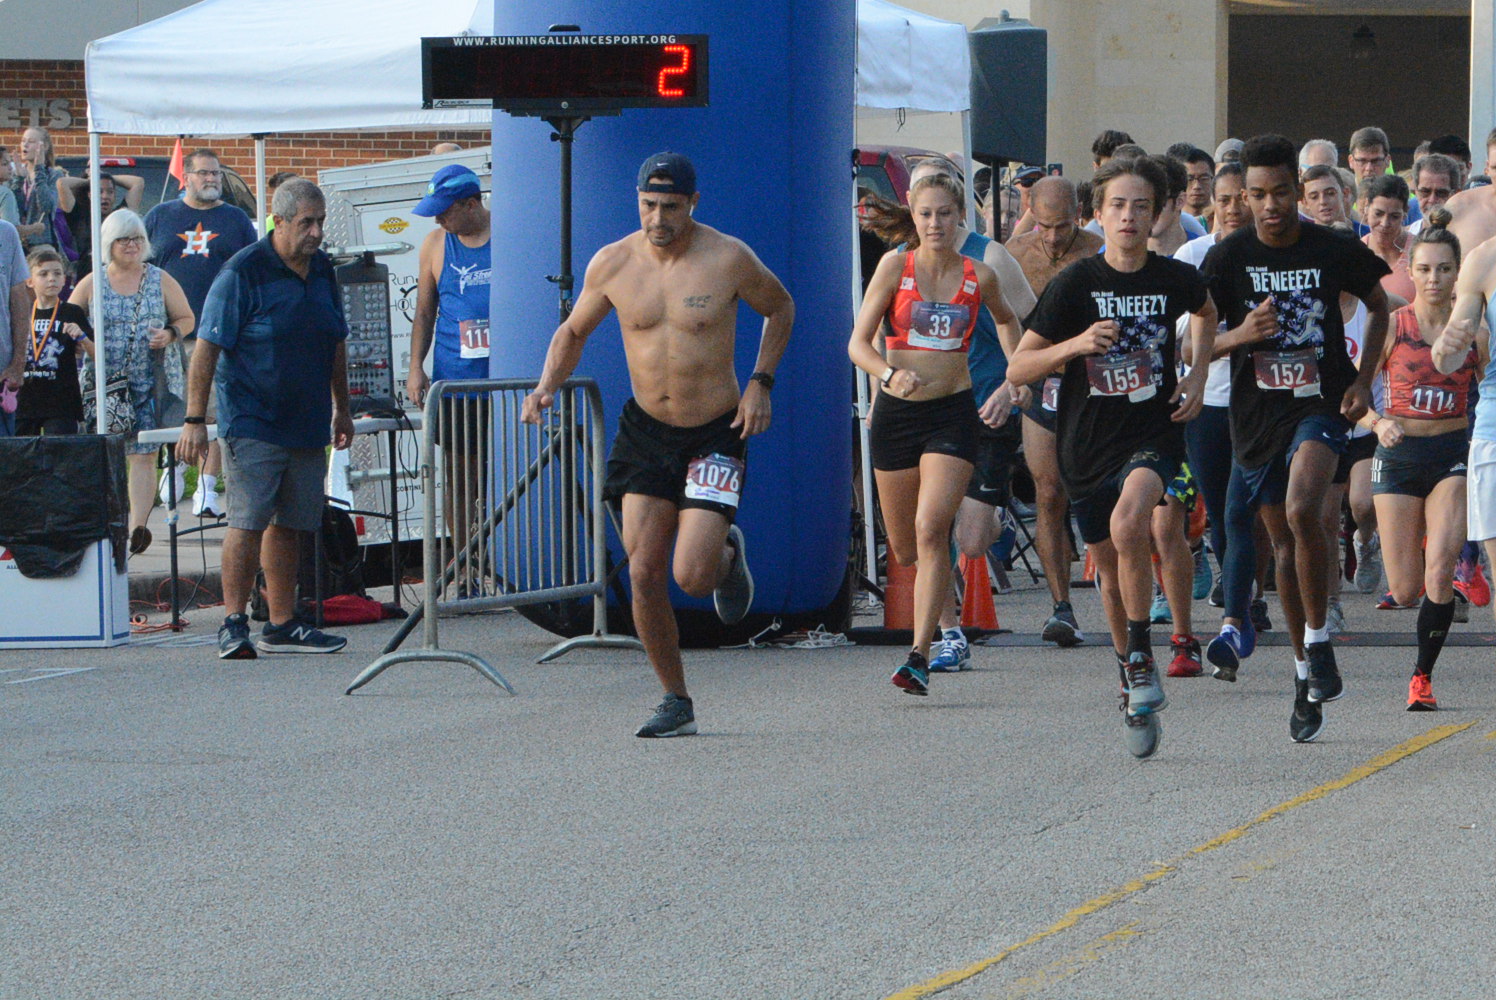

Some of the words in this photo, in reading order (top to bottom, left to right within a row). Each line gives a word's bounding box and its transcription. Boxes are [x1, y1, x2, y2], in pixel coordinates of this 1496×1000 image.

[453, 35, 677, 47] WWW.RUNNINGALLIANCESPORT.ORG
[658, 44, 691, 97] 2
[1249, 268, 1321, 293] BENEEEZY
[1095, 294, 1167, 318] BENEEEZY
[928, 314, 951, 337] 33
[1102, 366, 1140, 392] 155
[1270, 363, 1306, 386] 152
[1414, 388, 1455, 412] 1114
[698, 463, 739, 491] 1076
